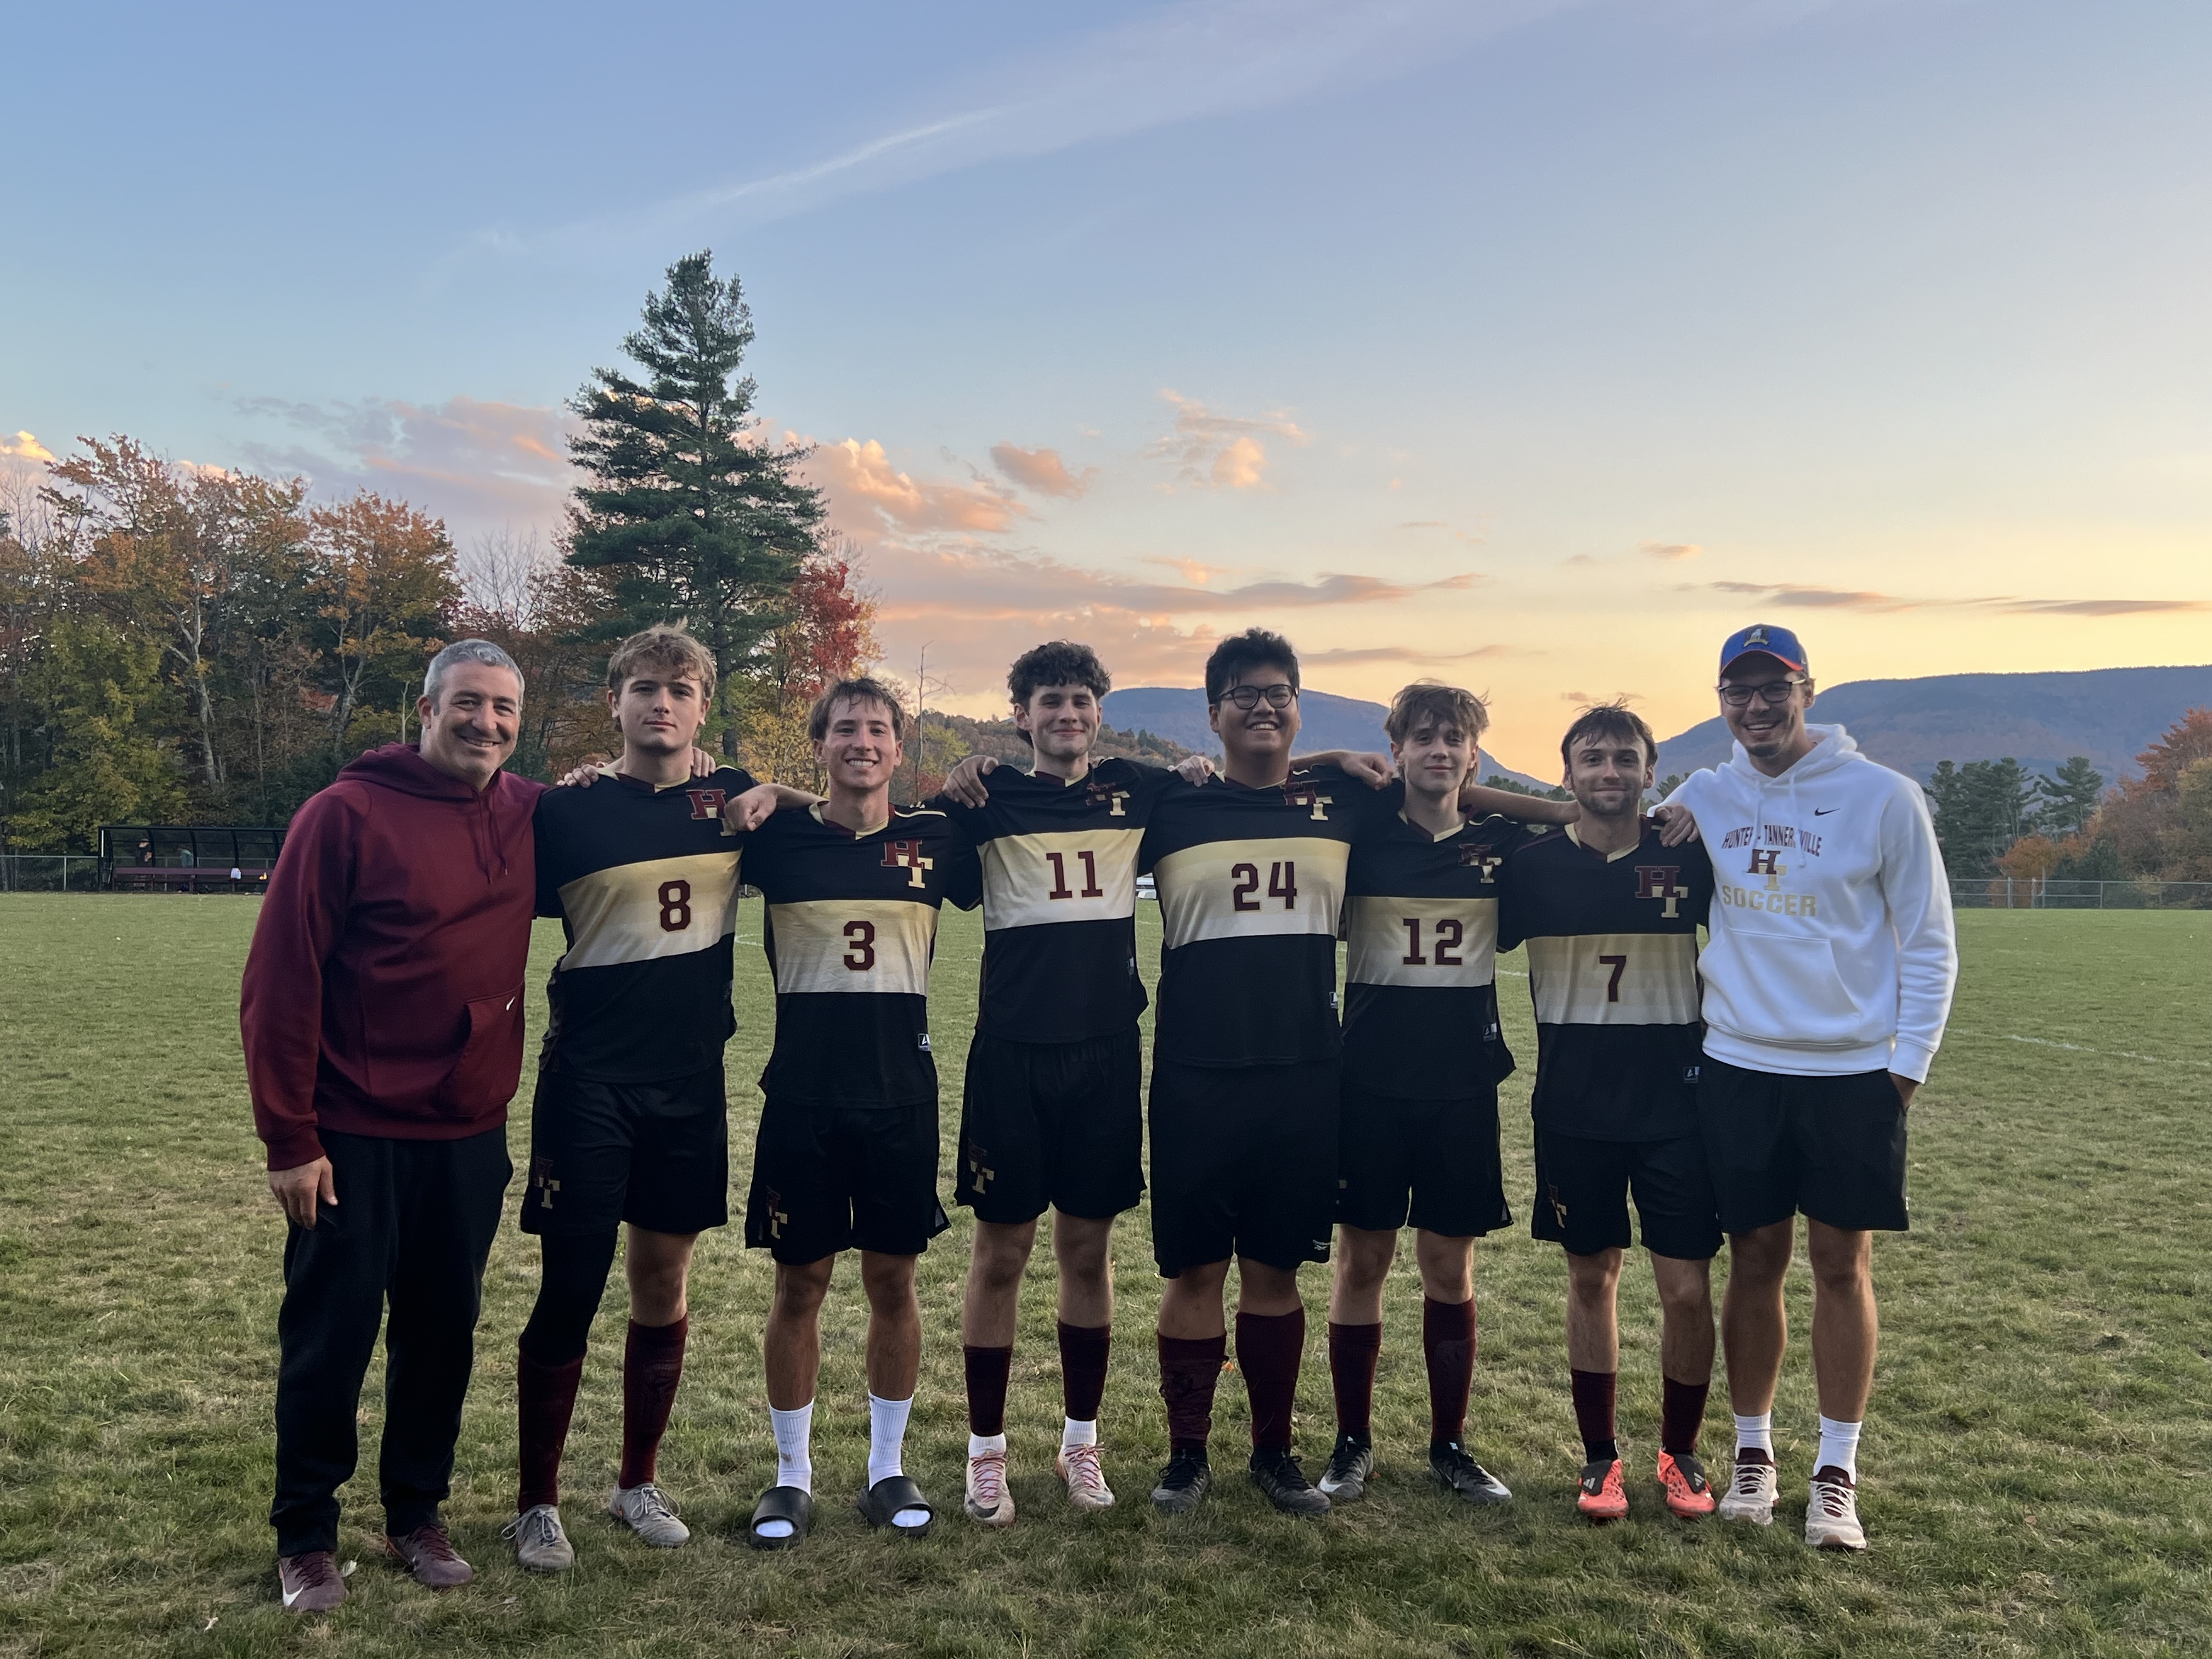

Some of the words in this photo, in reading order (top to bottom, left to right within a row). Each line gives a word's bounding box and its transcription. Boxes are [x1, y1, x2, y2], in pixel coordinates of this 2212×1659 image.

[881, 839, 933, 889] HT
[1764, 825, 1822, 857] TANNERVILLE
[1046, 850, 1103, 900] 11
[1231, 861, 1297, 911] 24
[1634, 865, 1689, 918] HT
[1746, 849, 1787, 891] HT
[658, 879, 691, 933] 8
[1722, 885, 1816, 917] SOCCER
[843, 921, 875, 972] 3
[1402, 918, 1463, 966] 12
[1599, 955, 1627, 1002] 7
